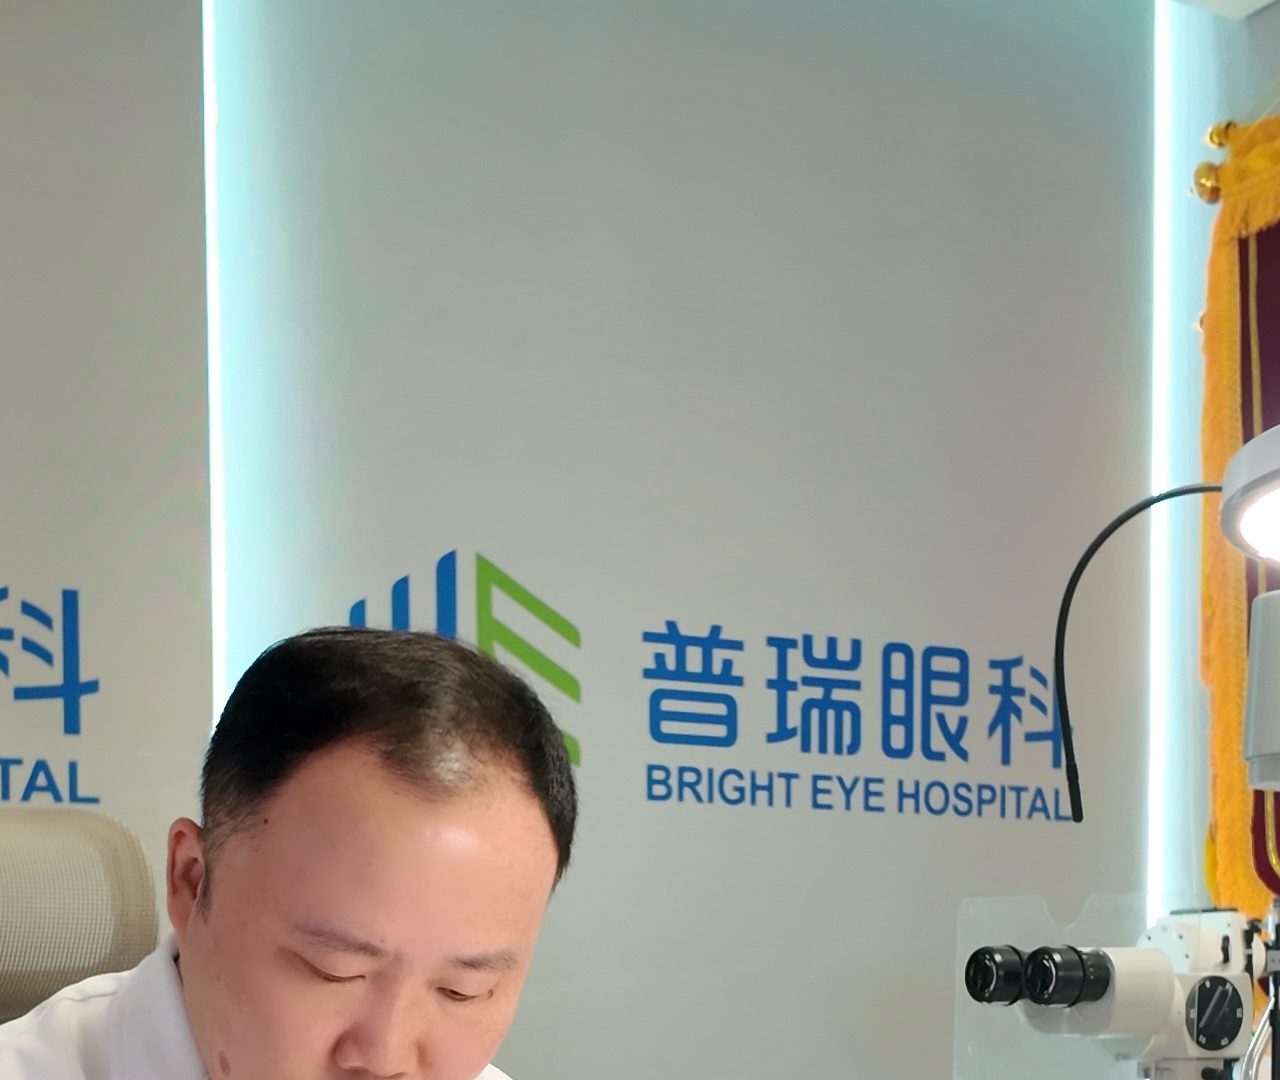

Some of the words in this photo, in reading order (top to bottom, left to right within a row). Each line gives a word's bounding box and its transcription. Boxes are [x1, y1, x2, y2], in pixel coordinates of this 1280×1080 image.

[642, 620, 1074, 769] 普瑞眼科
[646, 763, 800, 807] BRIGHT
[811, 773, 885, 813] EYE
[897, 779, 1072, 821] HOSPITAL
